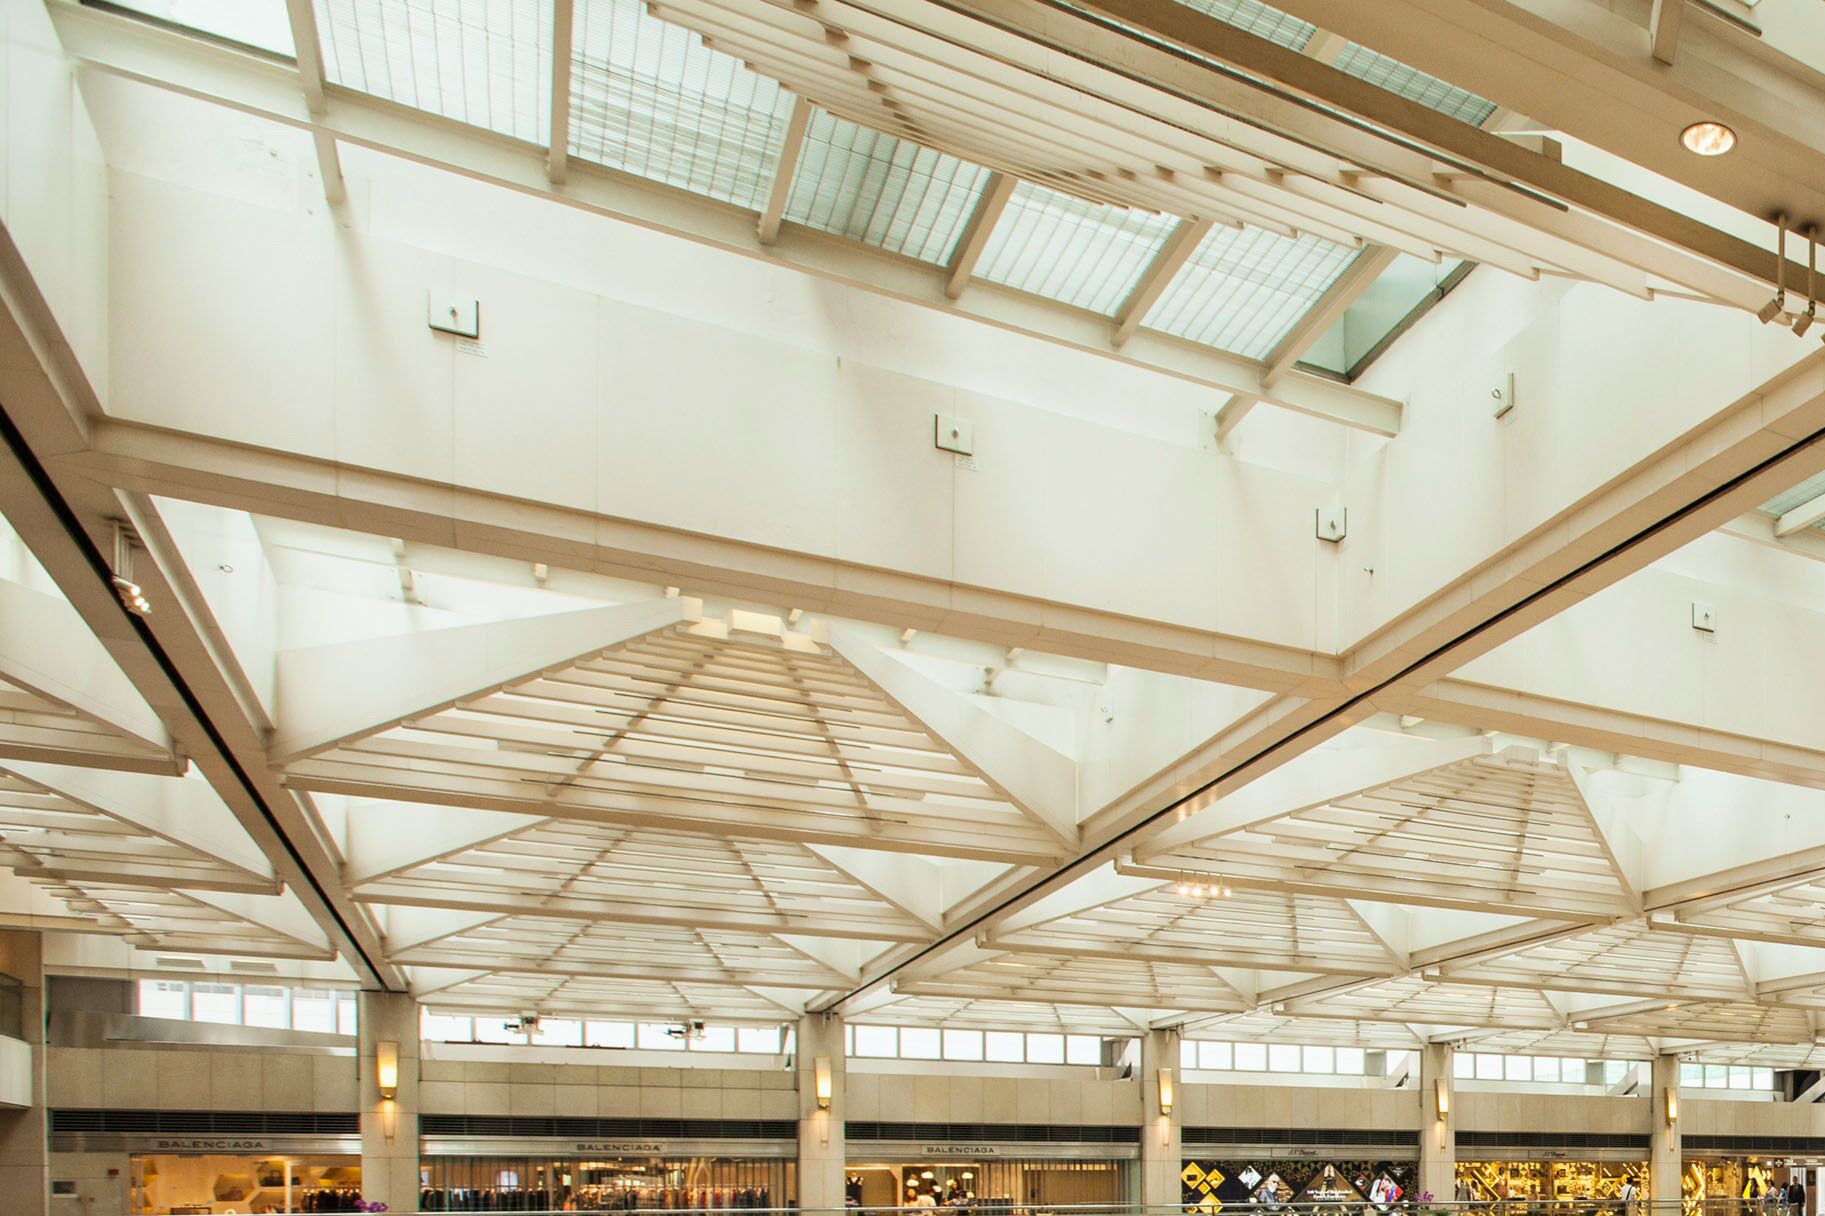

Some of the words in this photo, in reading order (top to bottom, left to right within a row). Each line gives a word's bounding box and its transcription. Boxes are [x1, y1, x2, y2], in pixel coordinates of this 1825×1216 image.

[158, 1140, 264, 1149] BALENCIAGA
[576, 1143, 661, 1152] BALENCIAGA
[926, 1145, 994, 1154] BALENCIAGA
